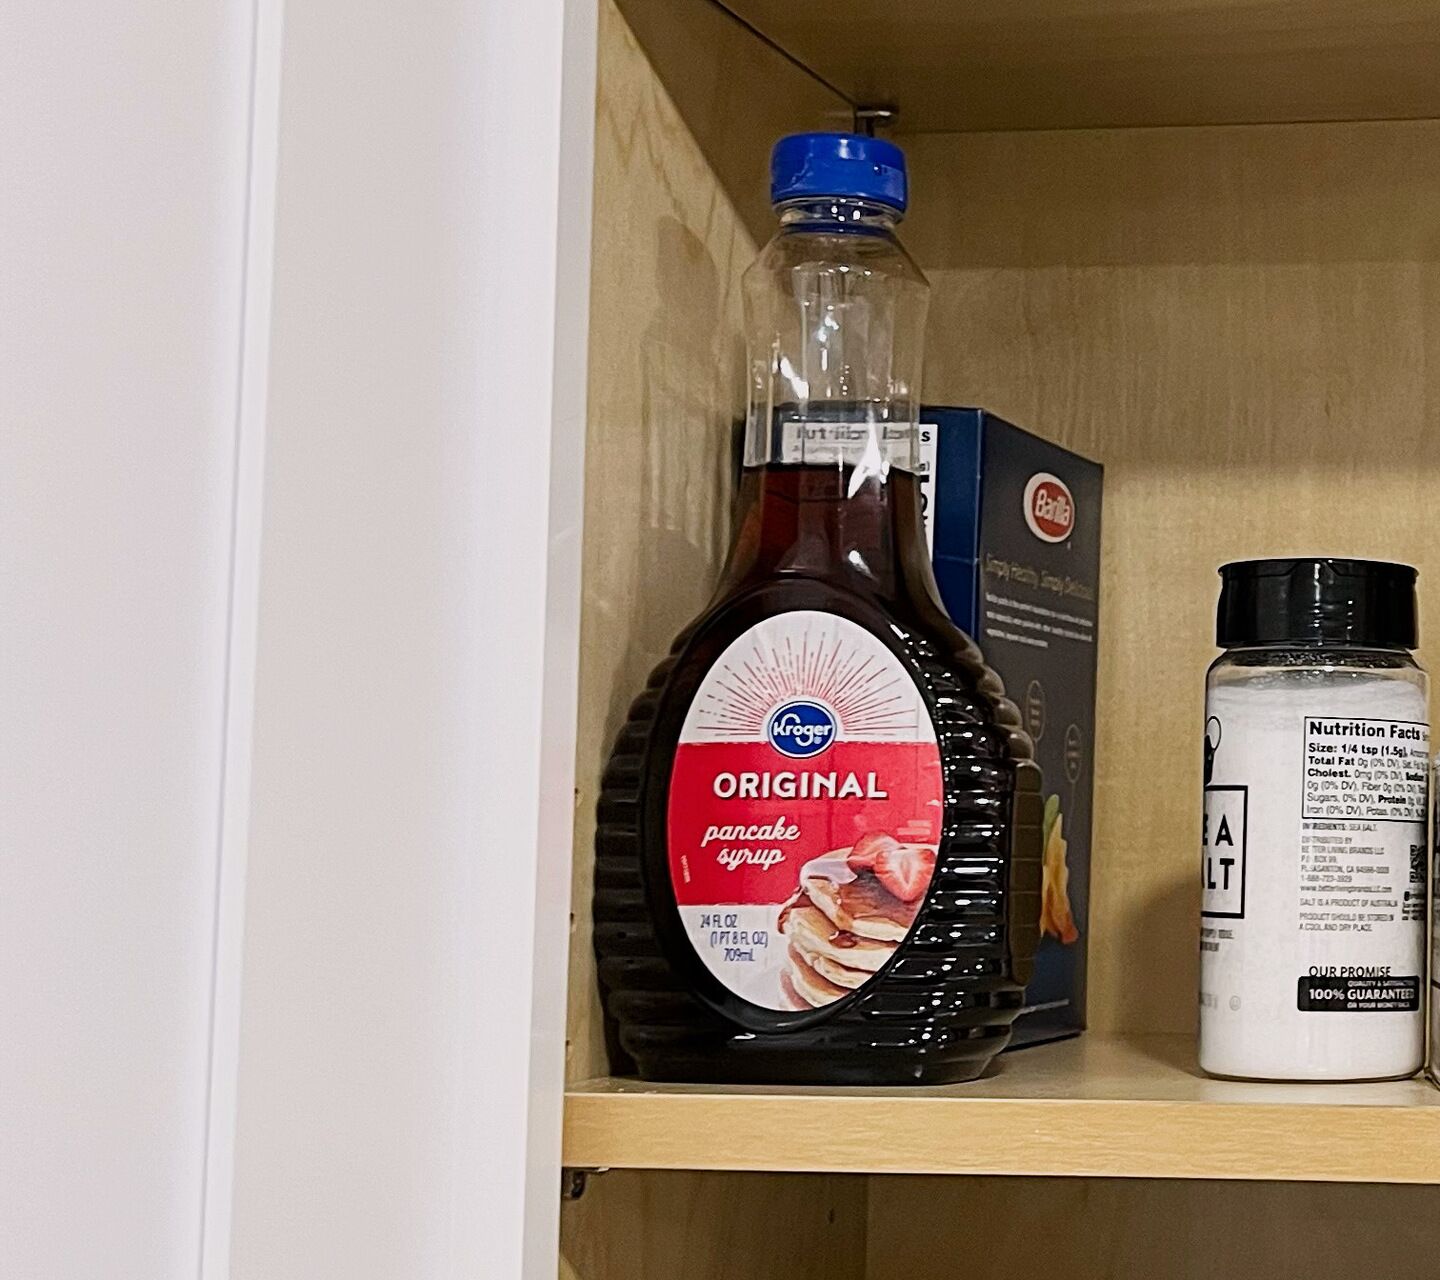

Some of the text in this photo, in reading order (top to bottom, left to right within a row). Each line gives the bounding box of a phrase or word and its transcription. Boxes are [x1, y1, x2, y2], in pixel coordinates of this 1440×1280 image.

[772, 713, 833, 746] Kroger
[1309, 721, 1421, 741] Nutrition Facts
[1308, 742, 1338, 753] Size:
[1341, 743, 1358, 754] 1/4
[1362, 744, 1378, 756] tsp
[1308, 755, 1355, 766] Total Fat
[1307, 768, 1351, 778] Cholest.
[713, 772, 888, 800] ORIGINAL
[1378, 794, 1407, 804] Protein
[700, 816, 801, 847] pancake
[717, 845, 787, 871] syrup
[701, 914, 738, 928] 24 FL OZ
[732, 931, 738, 945] 8
[740, 931, 750, 945] FL
[752, 931, 768, 948] OZ)
[1308, 966, 1391, 978] OUR PROMISE
[1309, 989, 1415, 1000] 100% GUARANTEED
